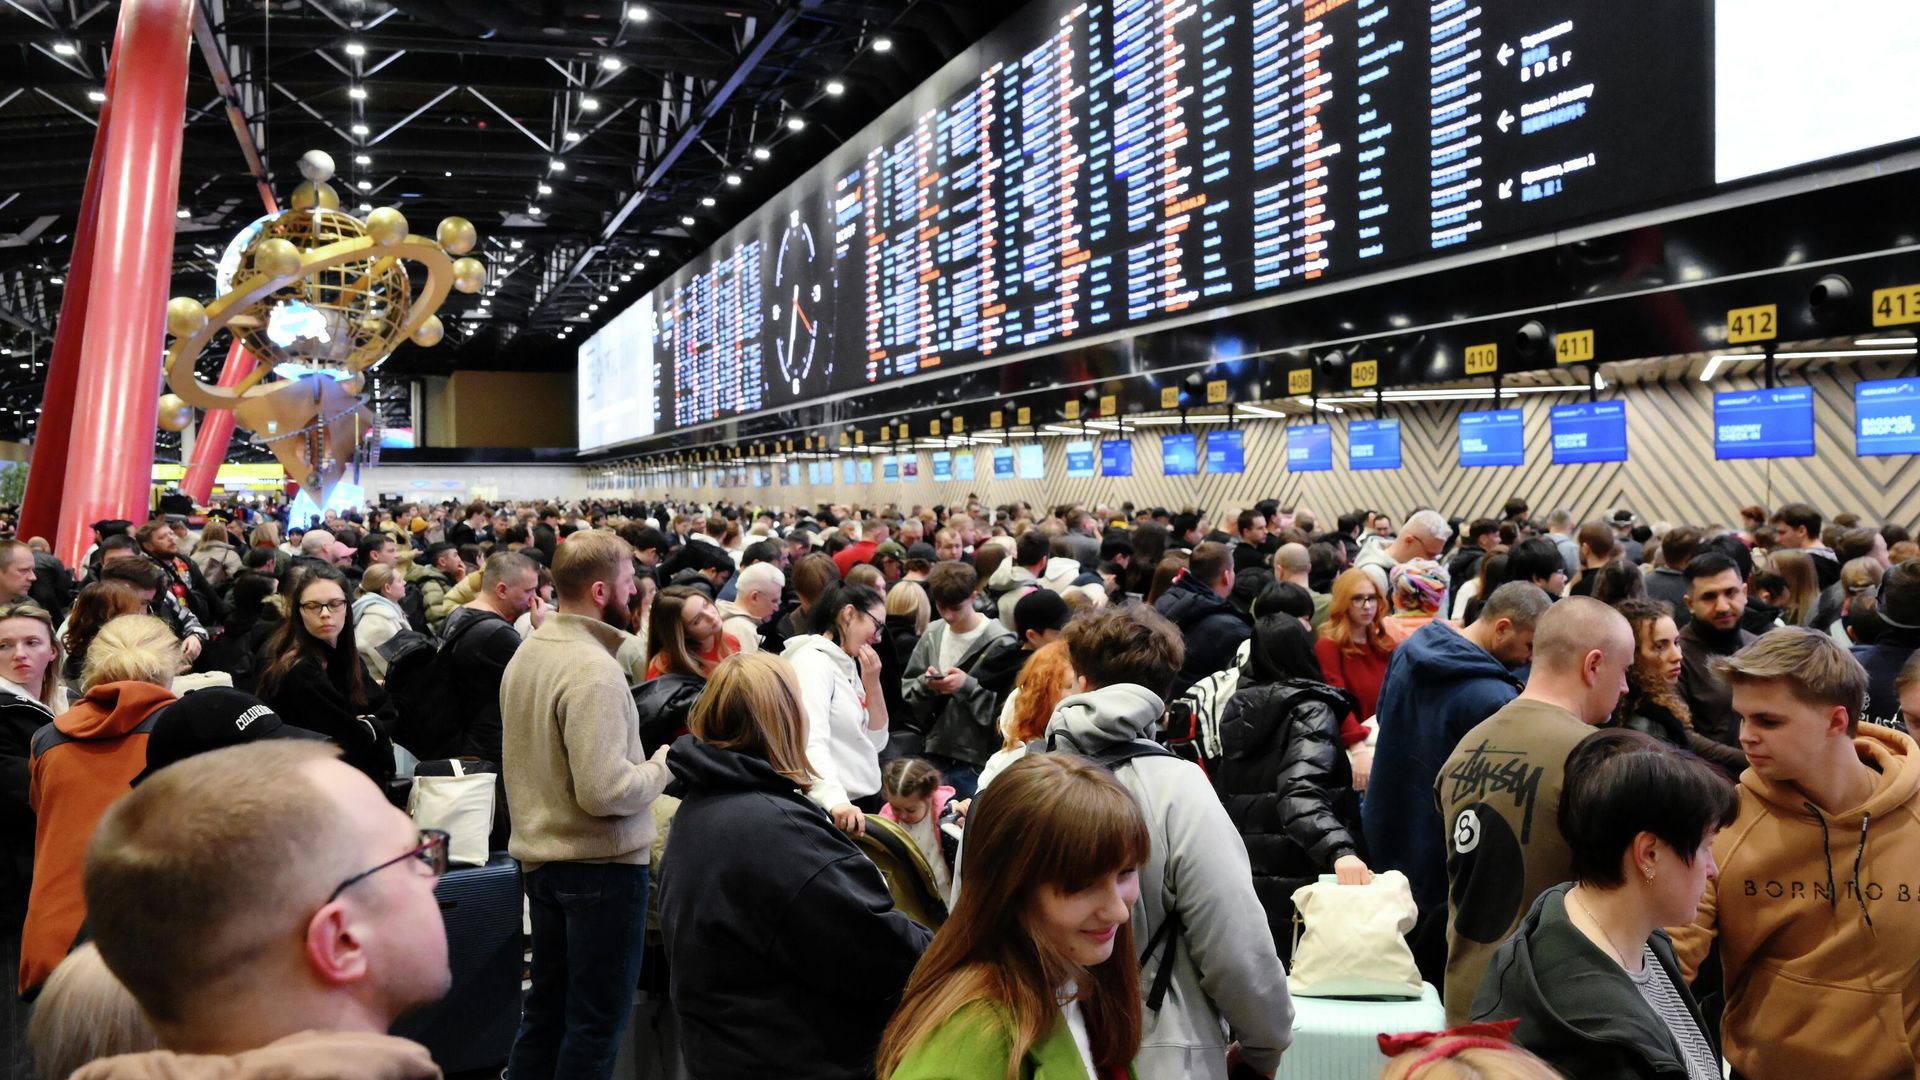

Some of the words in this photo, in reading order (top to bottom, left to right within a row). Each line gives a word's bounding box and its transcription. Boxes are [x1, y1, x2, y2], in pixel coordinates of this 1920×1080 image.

[1534, 61, 1545, 77] D
[1548, 56, 1558, 72] E
[1562, 50, 1572, 67] F
[1877, 291, 1920, 318] 413
[1731, 312, 1772, 336] 412
[1559, 336, 1588, 357] 411
[1467, 349, 1495, 368] 410
[1290, 373, 1310, 389] 408
[1353, 365, 1375, 382] 409
[1459, 815, 1475, 846] 8
[1744, 880, 1831, 900] BORN
[1843, 881, 1884, 901] TO
[1897, 884, 1920, 902] B
